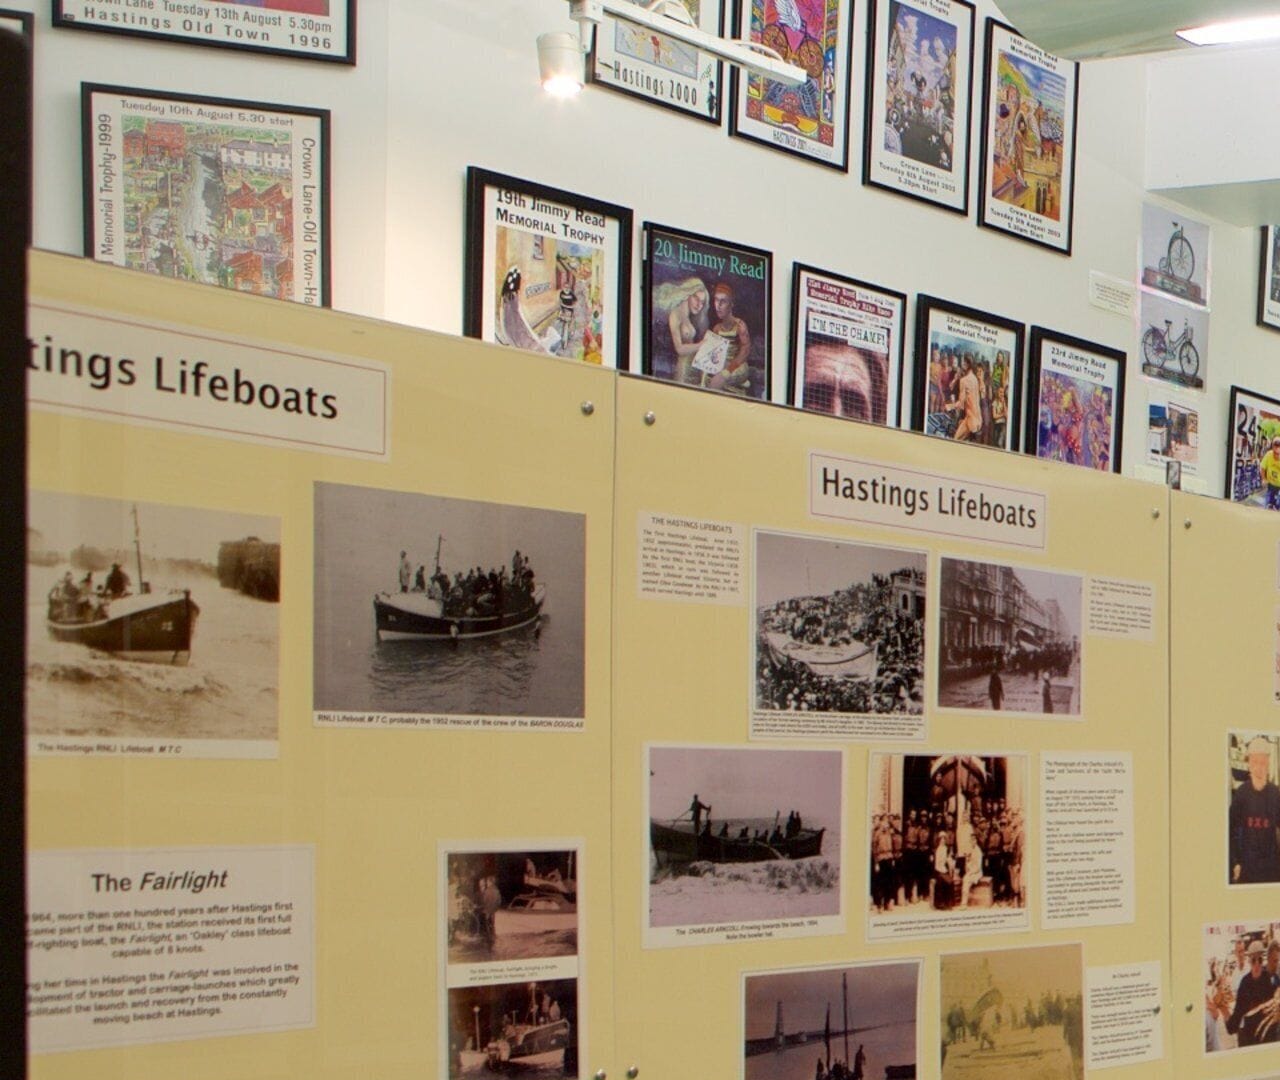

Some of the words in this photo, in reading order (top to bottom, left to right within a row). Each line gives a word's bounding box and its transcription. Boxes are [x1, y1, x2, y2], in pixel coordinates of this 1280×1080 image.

[85, 7, 172, 30] Hastings
[183, 20, 213, 34] Old
[225, 25, 271, 42] Town
[290, 34, 332, 50] 1996
[164, 1, 210, 18] Tuesday
[216, 8, 240, 21] 13th
[243, 12, 283, 28] August
[290, 16, 332, 33] 5.30pm
[614, 61, 665, 96] Hastings
[671, 80, 698, 106] 2000
[121, 100, 165, 116] Tuesday
[170, 105, 193, 116] 10th
[198, 108, 234, 121] August
[239, 114, 266, 124] 5.30
[271, 119, 294, 127] start
[302, 138, 316, 180] Crown
[774, 131, 798, 149] HASTINGS
[101, 199, 114, 256] Memorial
[496, 207, 557, 235] MEMORIAL
[563, 222, 605, 245] TROPHY
[497, 190, 527, 208] 19th
[531, 194, 570, 221] Jimmy
[575, 210, 606, 229] Read
[678, 243, 726, 276] Jimmy
[730, 256, 765, 280] Read
[829, 322, 849, 337] THE
[27, 335, 137, 390] tings
[156, 356, 338, 419] Lifeboats
[1051, 358, 1082, 373] Memorial
[823, 467, 930, 515] Hastings
[937, 488, 1037, 528] Lifeboats
[92, 873, 132, 892] The
[140, 870, 229, 893] Fairlight
